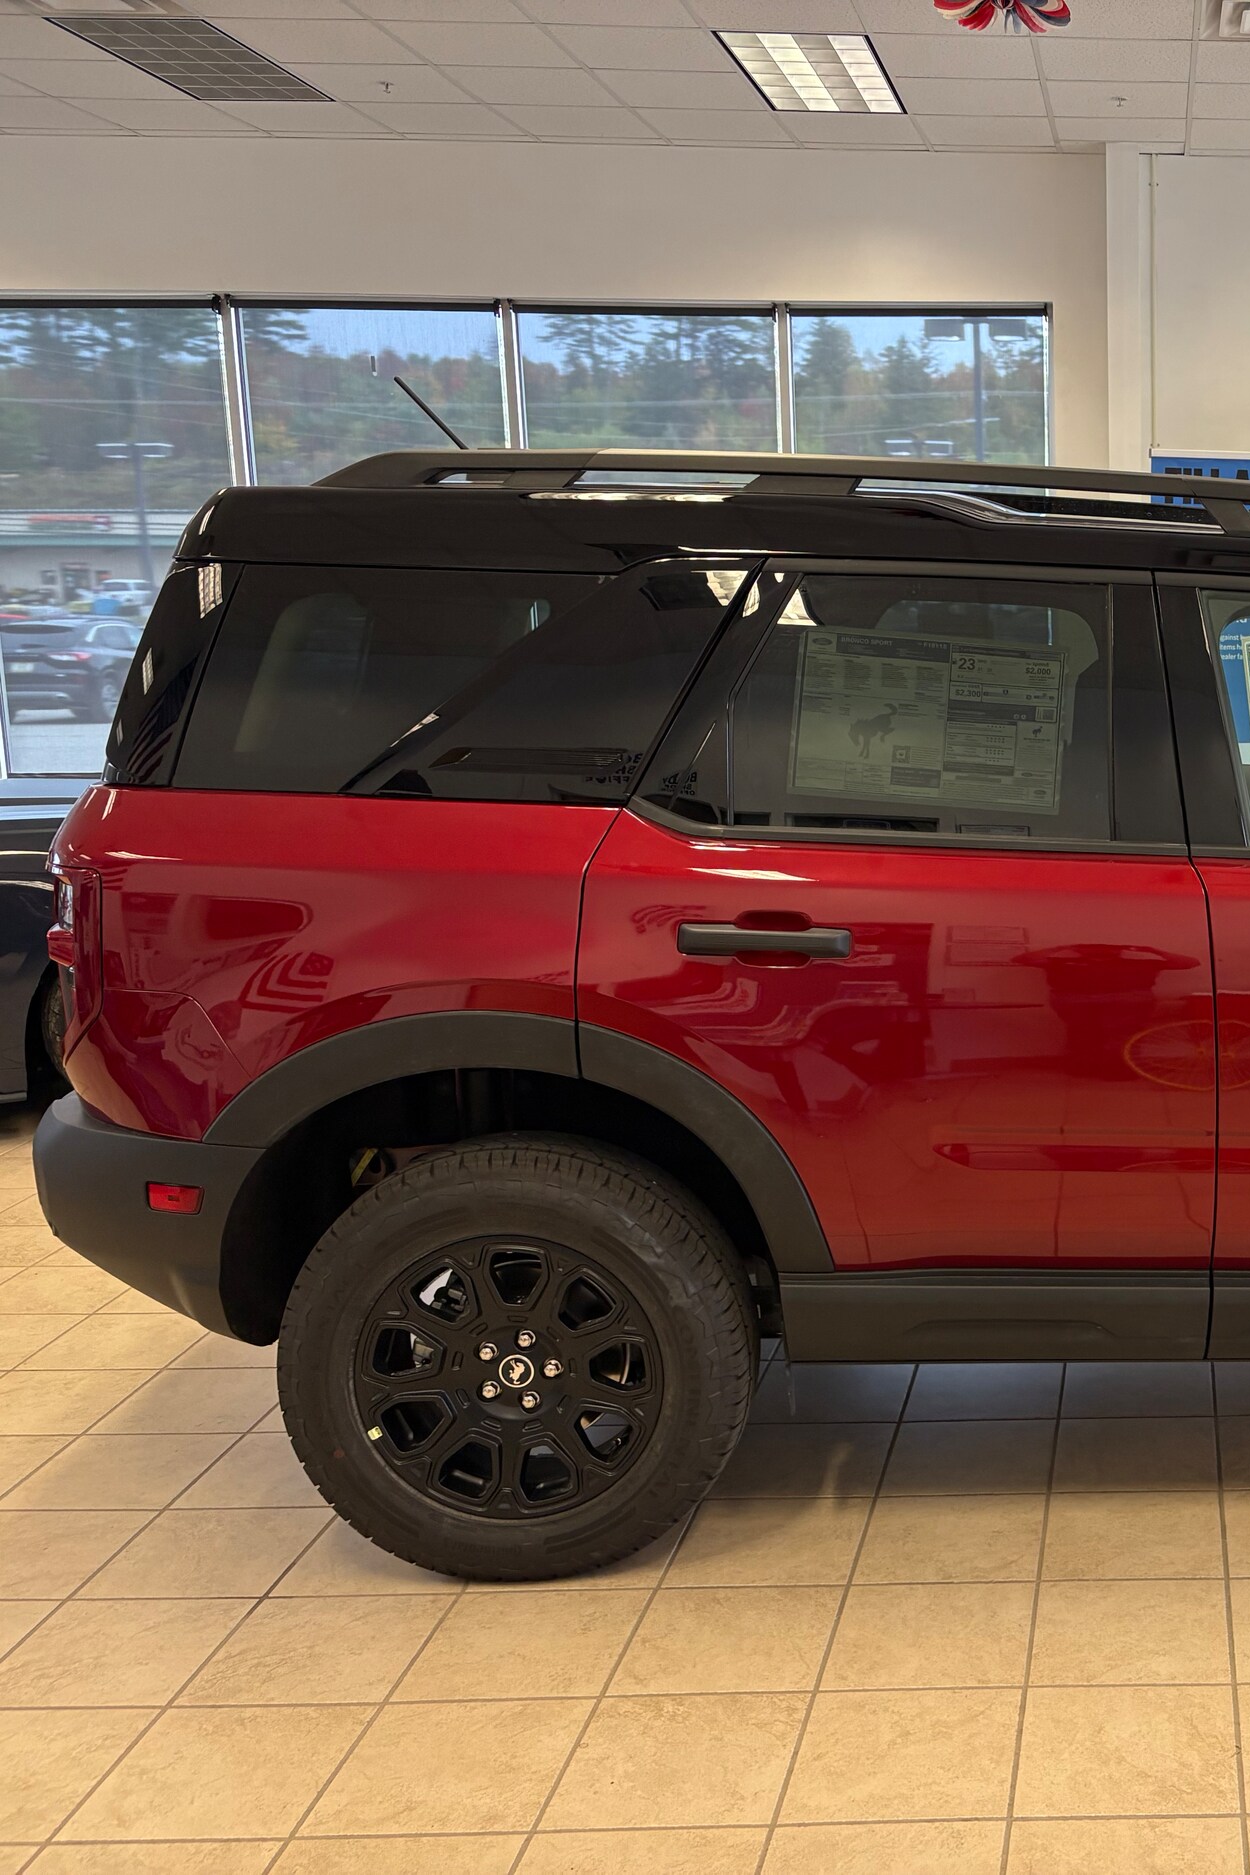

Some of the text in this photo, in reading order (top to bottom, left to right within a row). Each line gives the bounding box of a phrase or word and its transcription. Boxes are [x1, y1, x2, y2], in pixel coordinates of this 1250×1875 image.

[841, 636, 893, 647] BRONCO SPORT
[1220, 634, 1239, 643] gainst
[958, 657, 976, 671] 23
